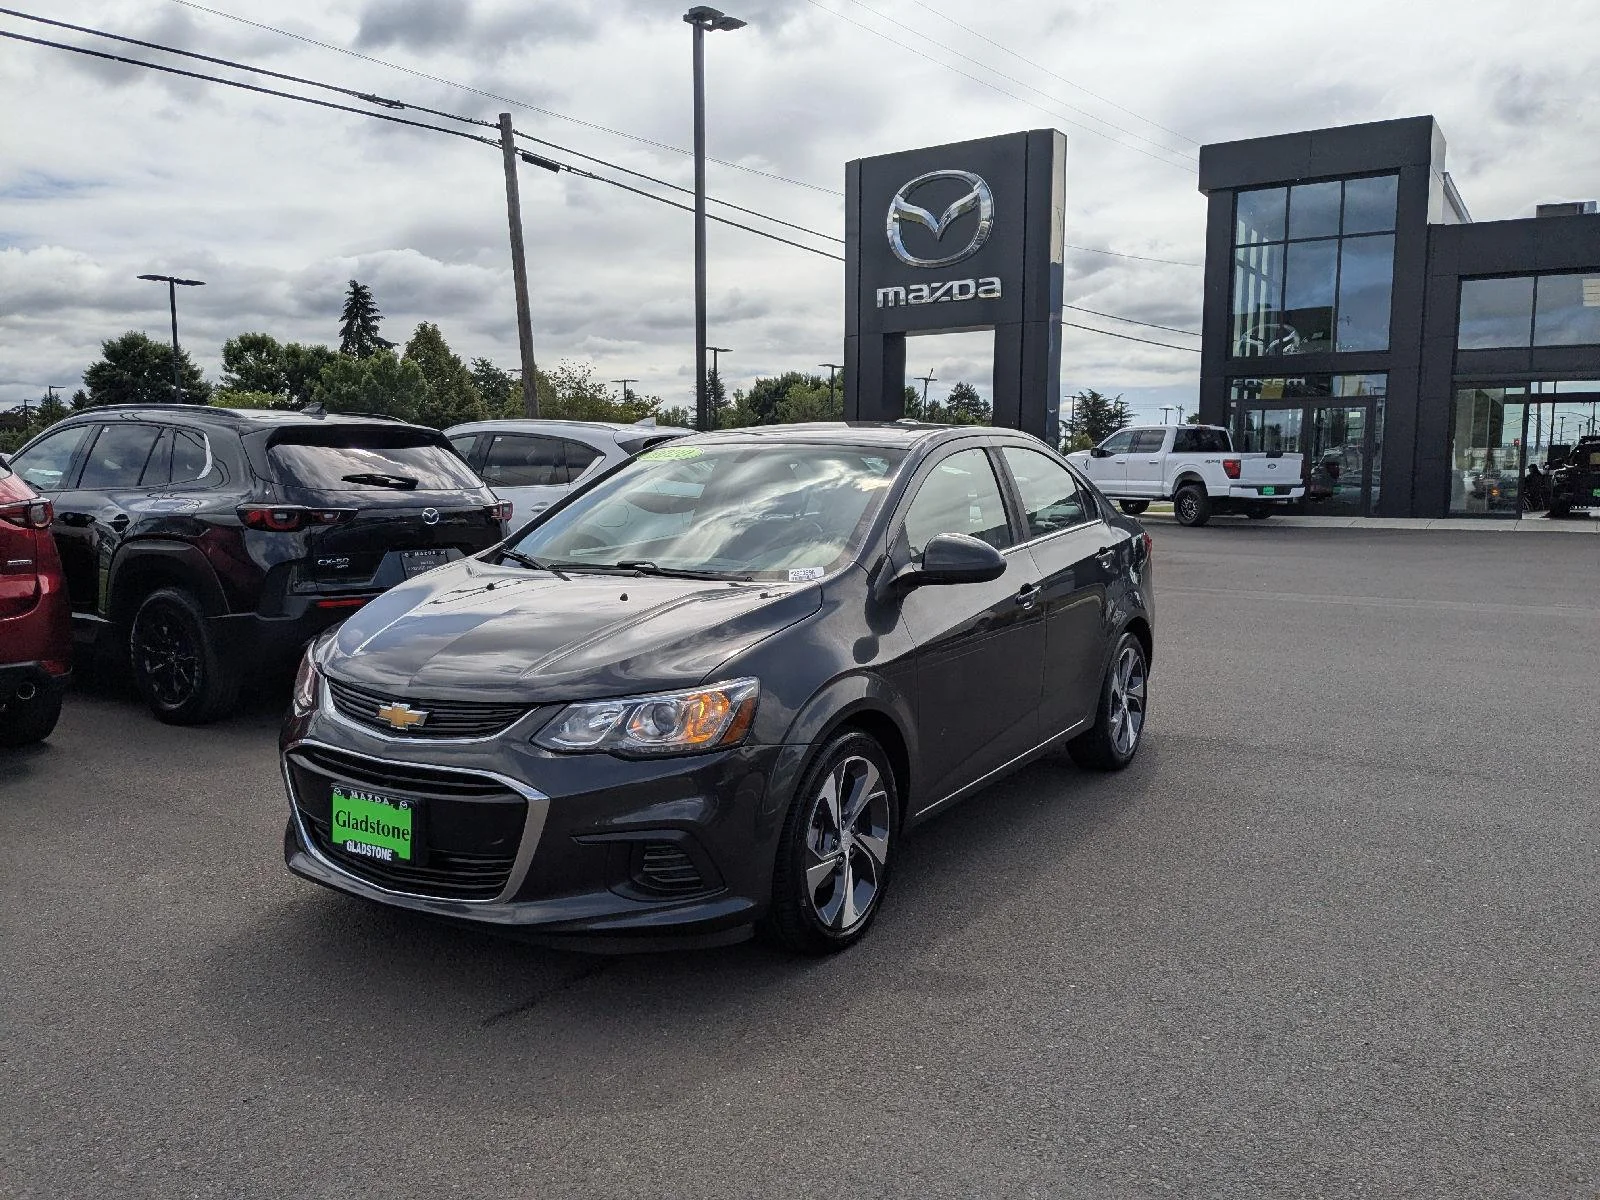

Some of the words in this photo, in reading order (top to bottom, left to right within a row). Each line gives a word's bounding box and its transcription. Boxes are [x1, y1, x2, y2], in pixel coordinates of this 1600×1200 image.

[876, 276, 1002, 308] mazda
[350, 790, 389, 805] MAZDA
[335, 810, 410, 841] Gladstone
[346, 840, 392, 861] GLADSTONE
